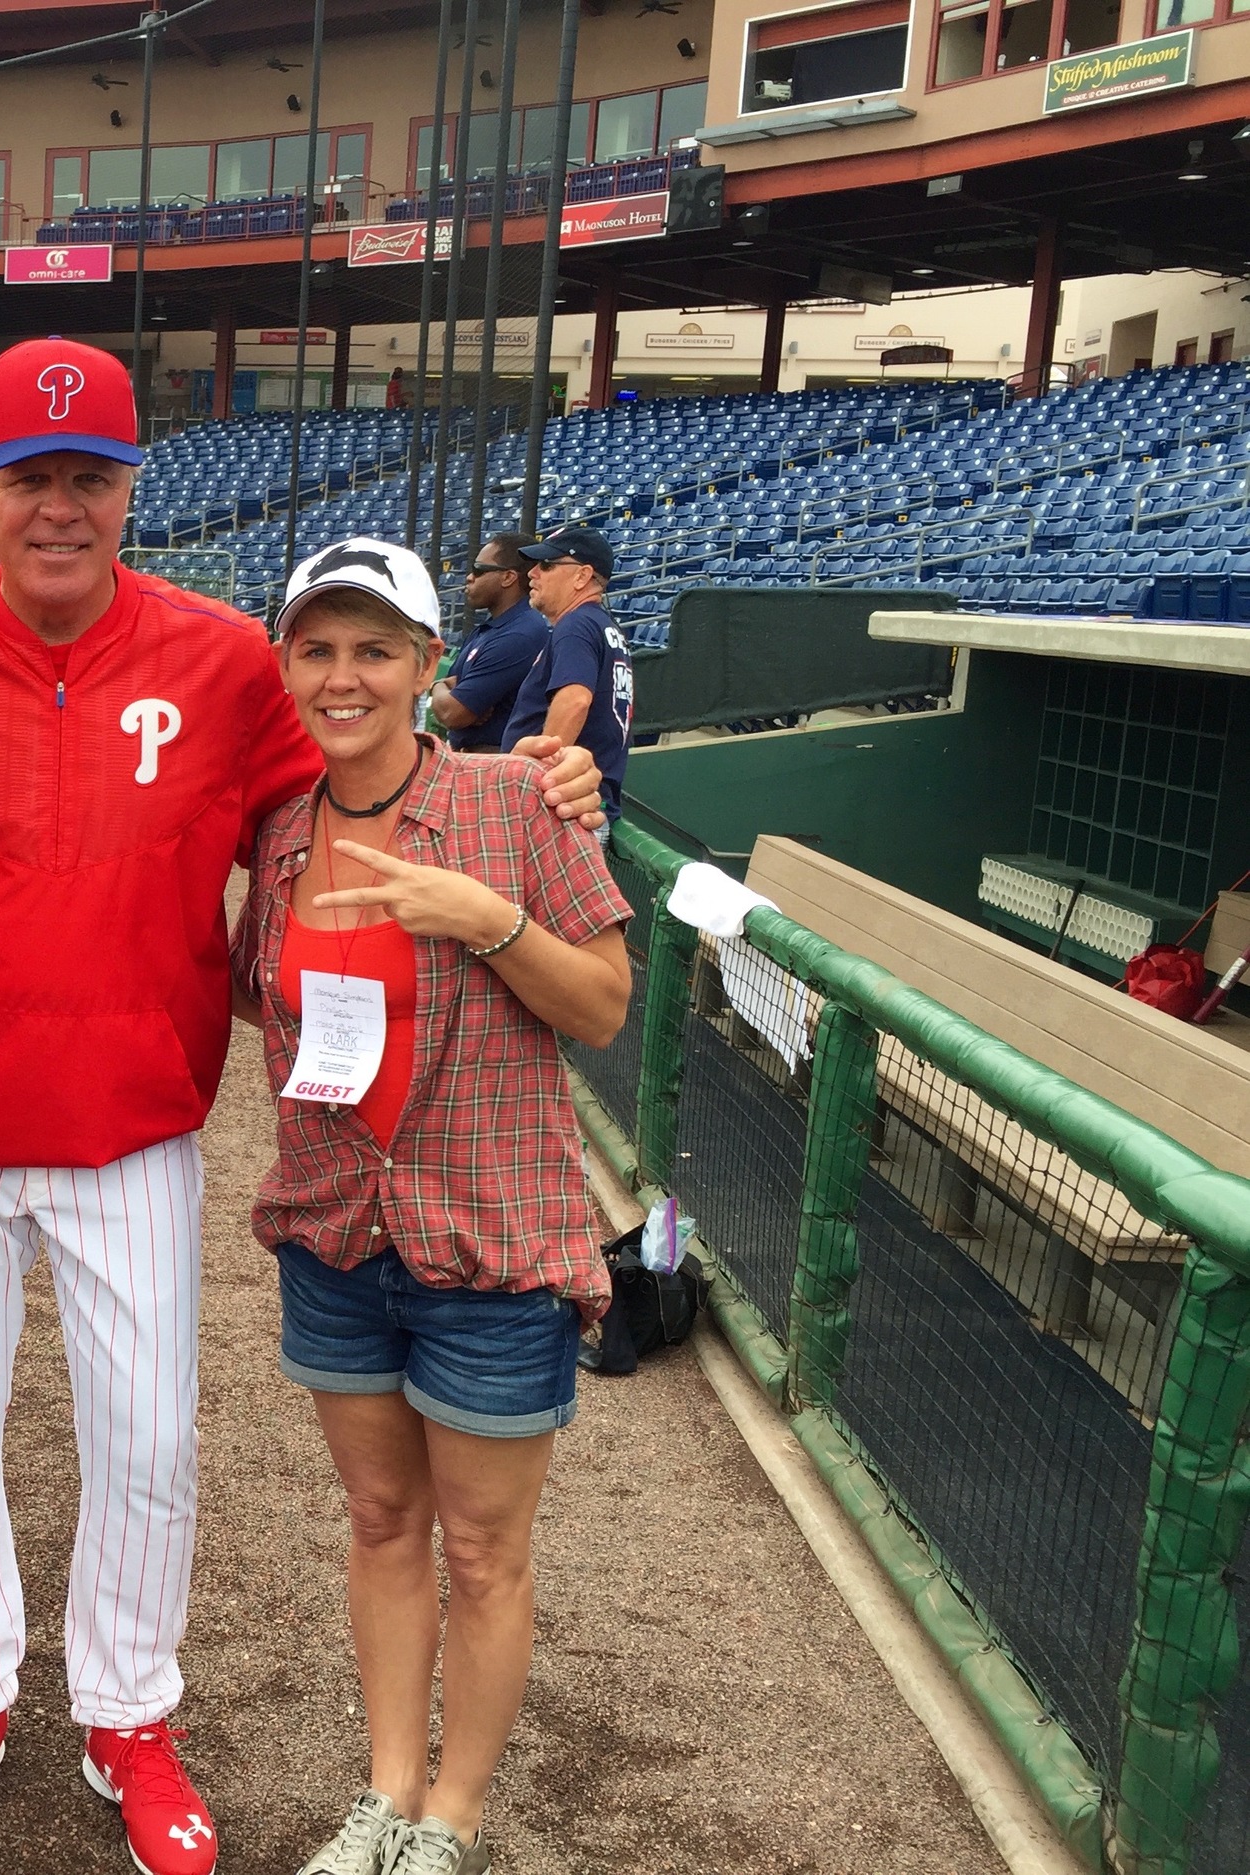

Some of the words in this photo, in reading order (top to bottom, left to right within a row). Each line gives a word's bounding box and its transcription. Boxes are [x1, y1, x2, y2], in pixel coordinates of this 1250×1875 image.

[1049, 59, 1100, 92] Stuffed
[1091, 46, 1186, 89] Mushroom
[1063, 90, 1088, 104] UNIQUE
[1095, 83, 1130, 98] CREATIVE
[1130, 75, 1166, 90] CATERING
[355, 238, 416, 252] Budweiser
[28, 269, 86, 279] omni-care
[120, 698, 181, 785] P
[323, 1032, 358, 1048] CLARK
[295, 1081, 355, 1099] GUEST
